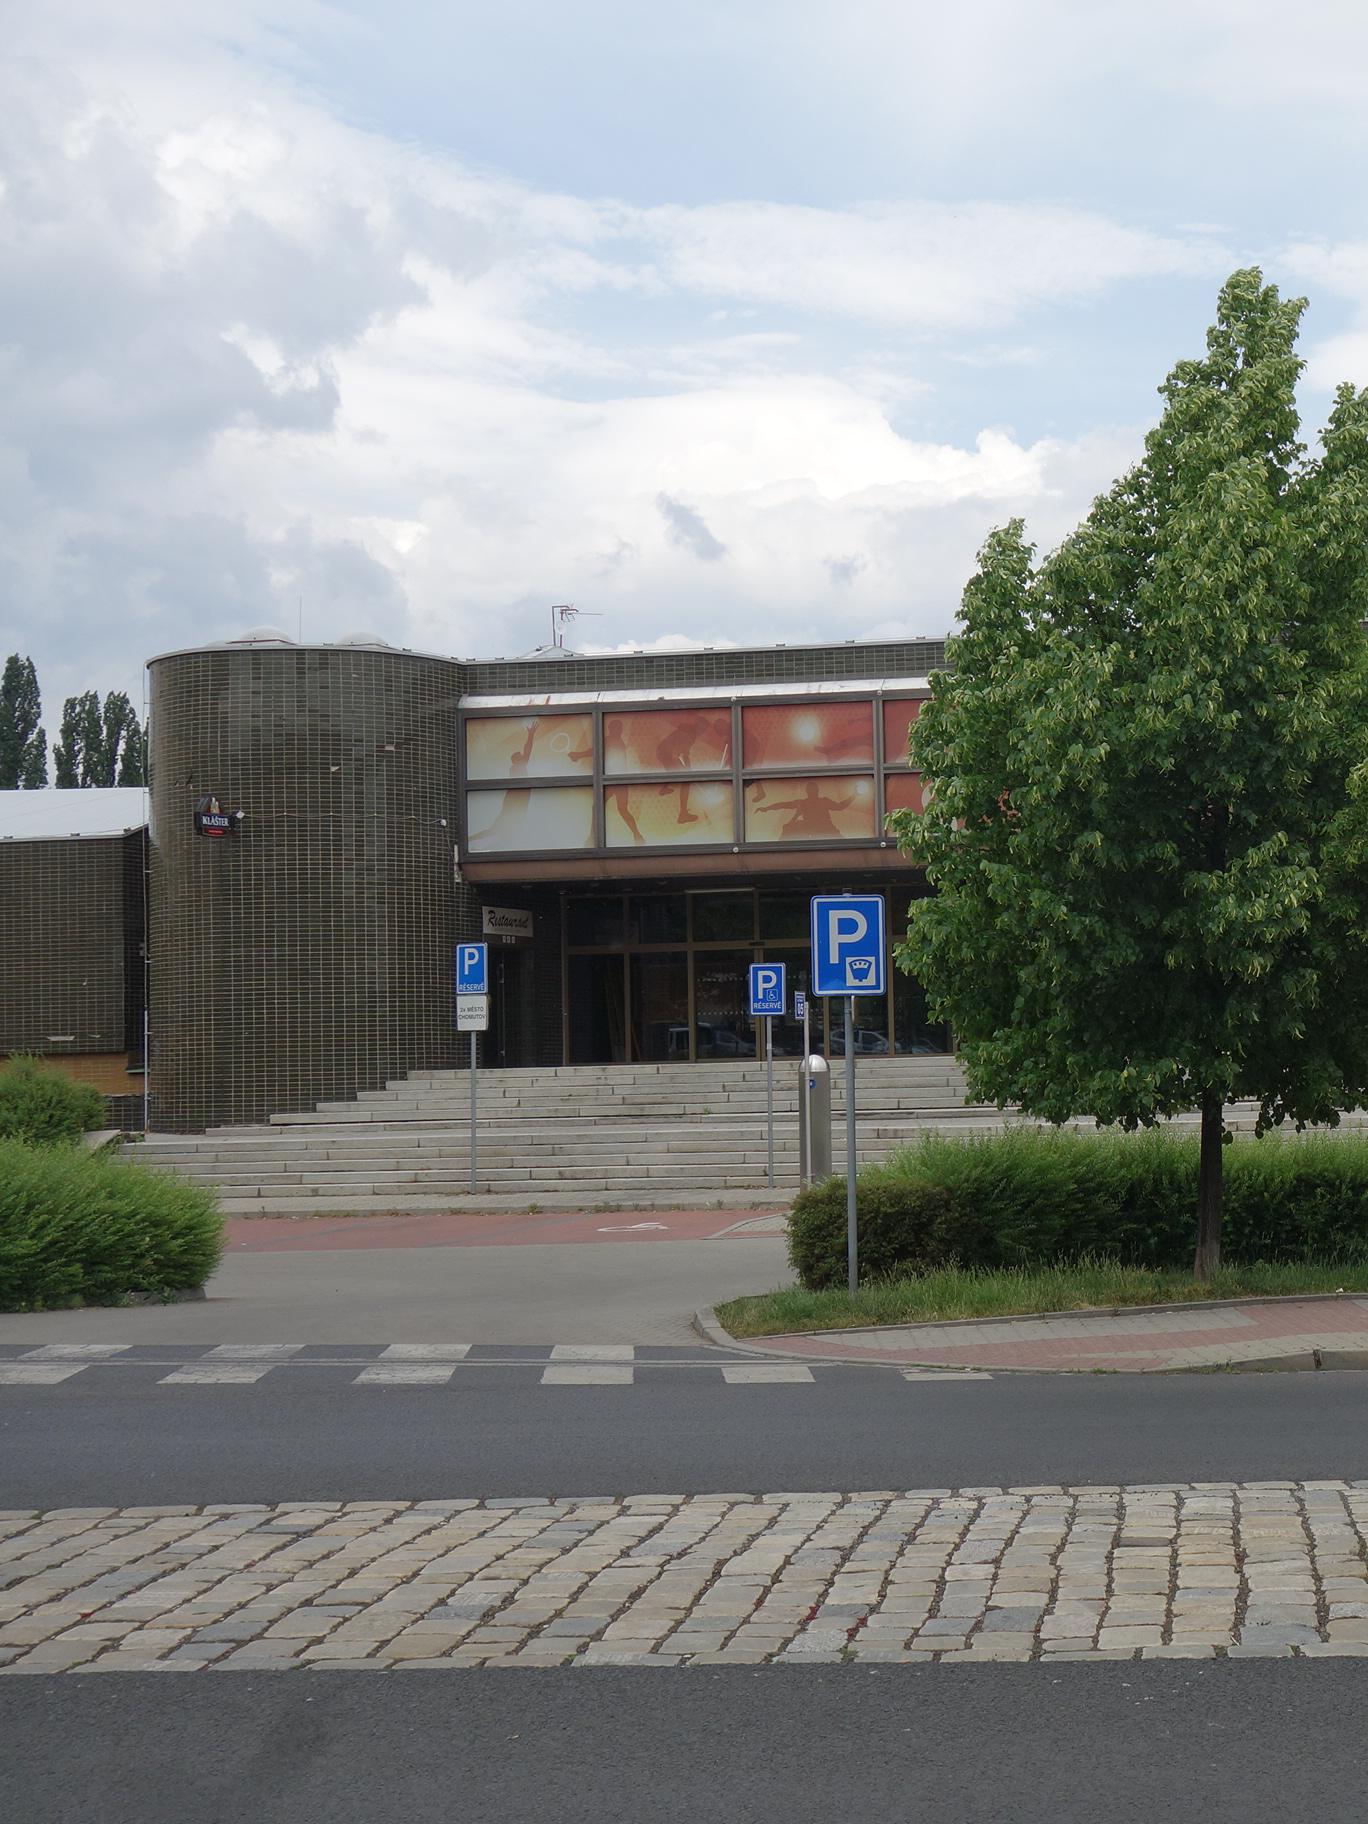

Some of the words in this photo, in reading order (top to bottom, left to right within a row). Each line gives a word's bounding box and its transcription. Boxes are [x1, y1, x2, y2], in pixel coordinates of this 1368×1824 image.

[829, 909, 868, 964] P
[464, 947, 479, 976] P
[757, 970, 777, 1000] P
[753, 1000, 782, 1010] RÉSERVÉ
